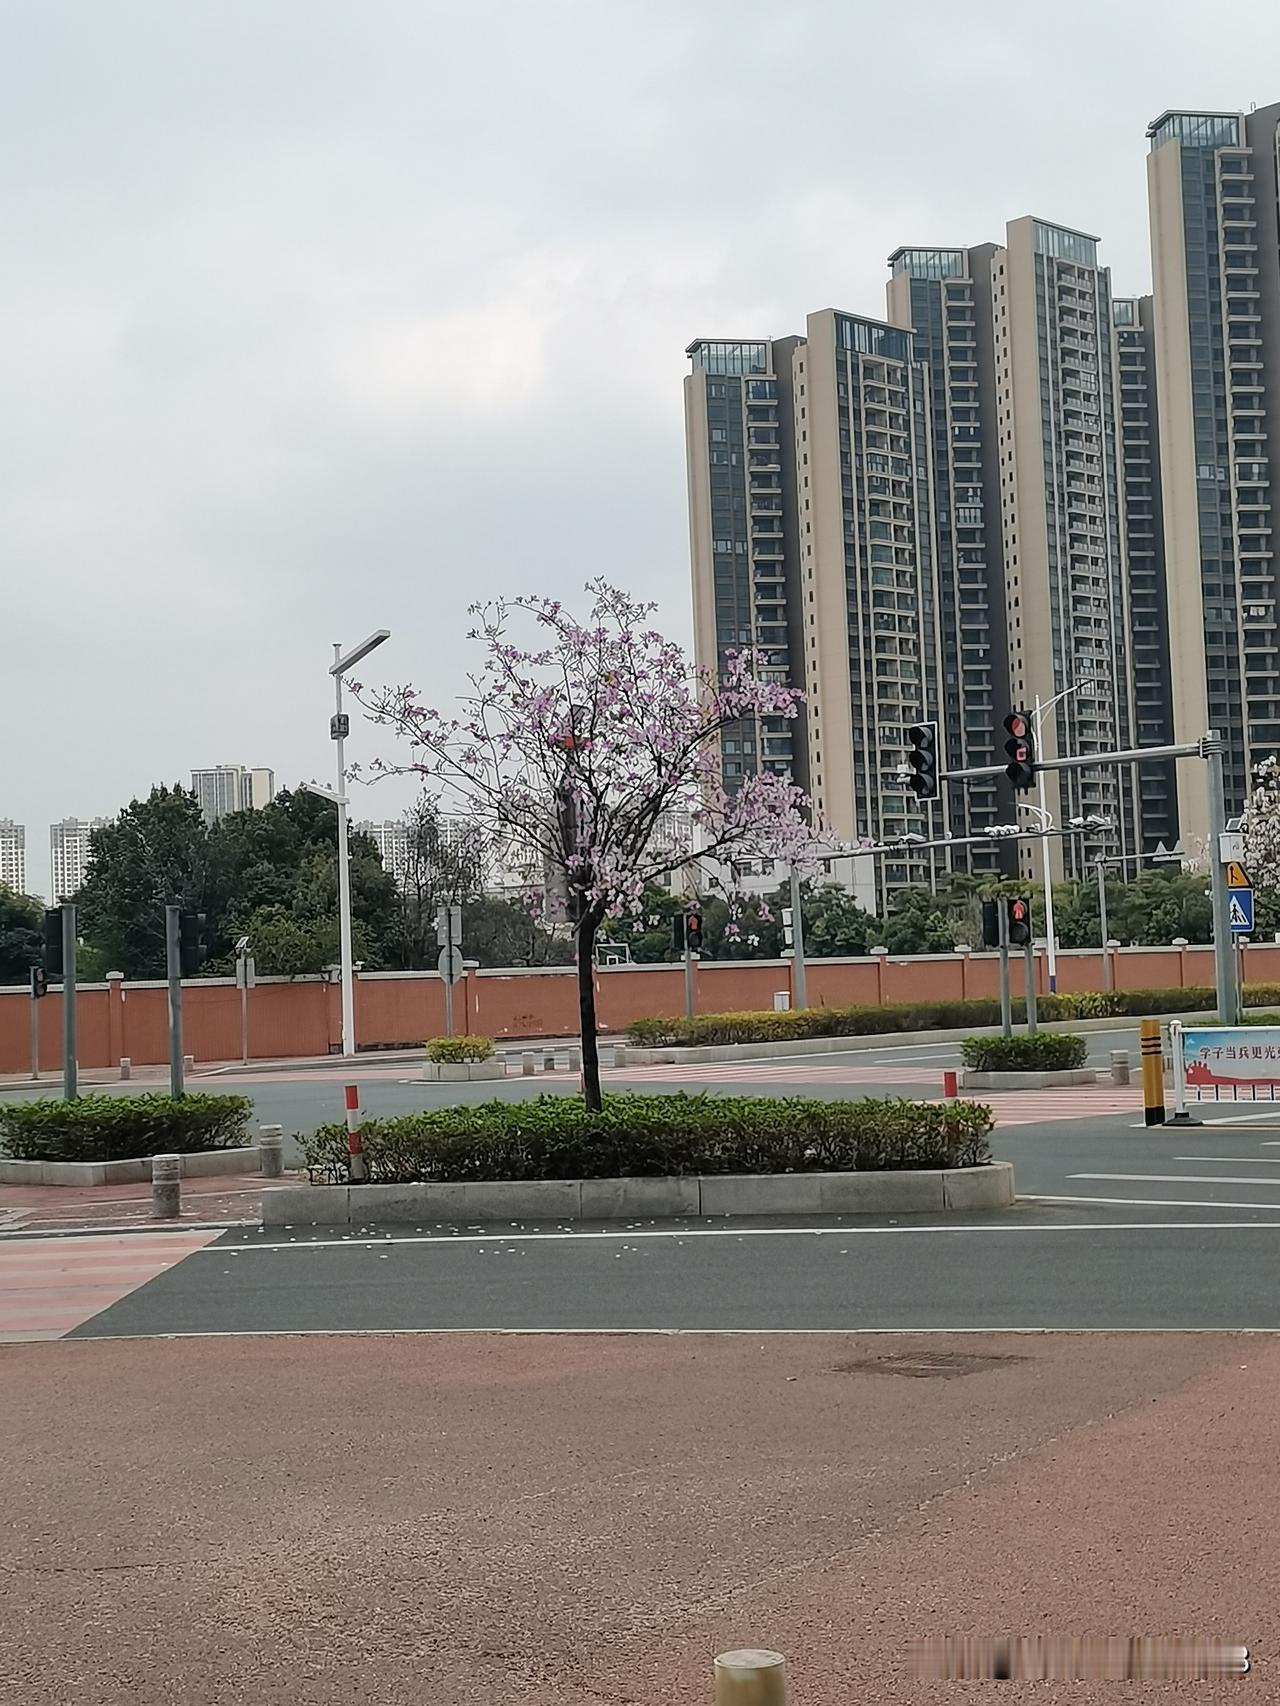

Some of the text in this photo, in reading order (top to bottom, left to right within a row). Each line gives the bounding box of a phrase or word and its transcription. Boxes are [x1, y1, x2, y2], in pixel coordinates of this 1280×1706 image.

[1200, 1046, 1280, 1060] 学子当兵更光
